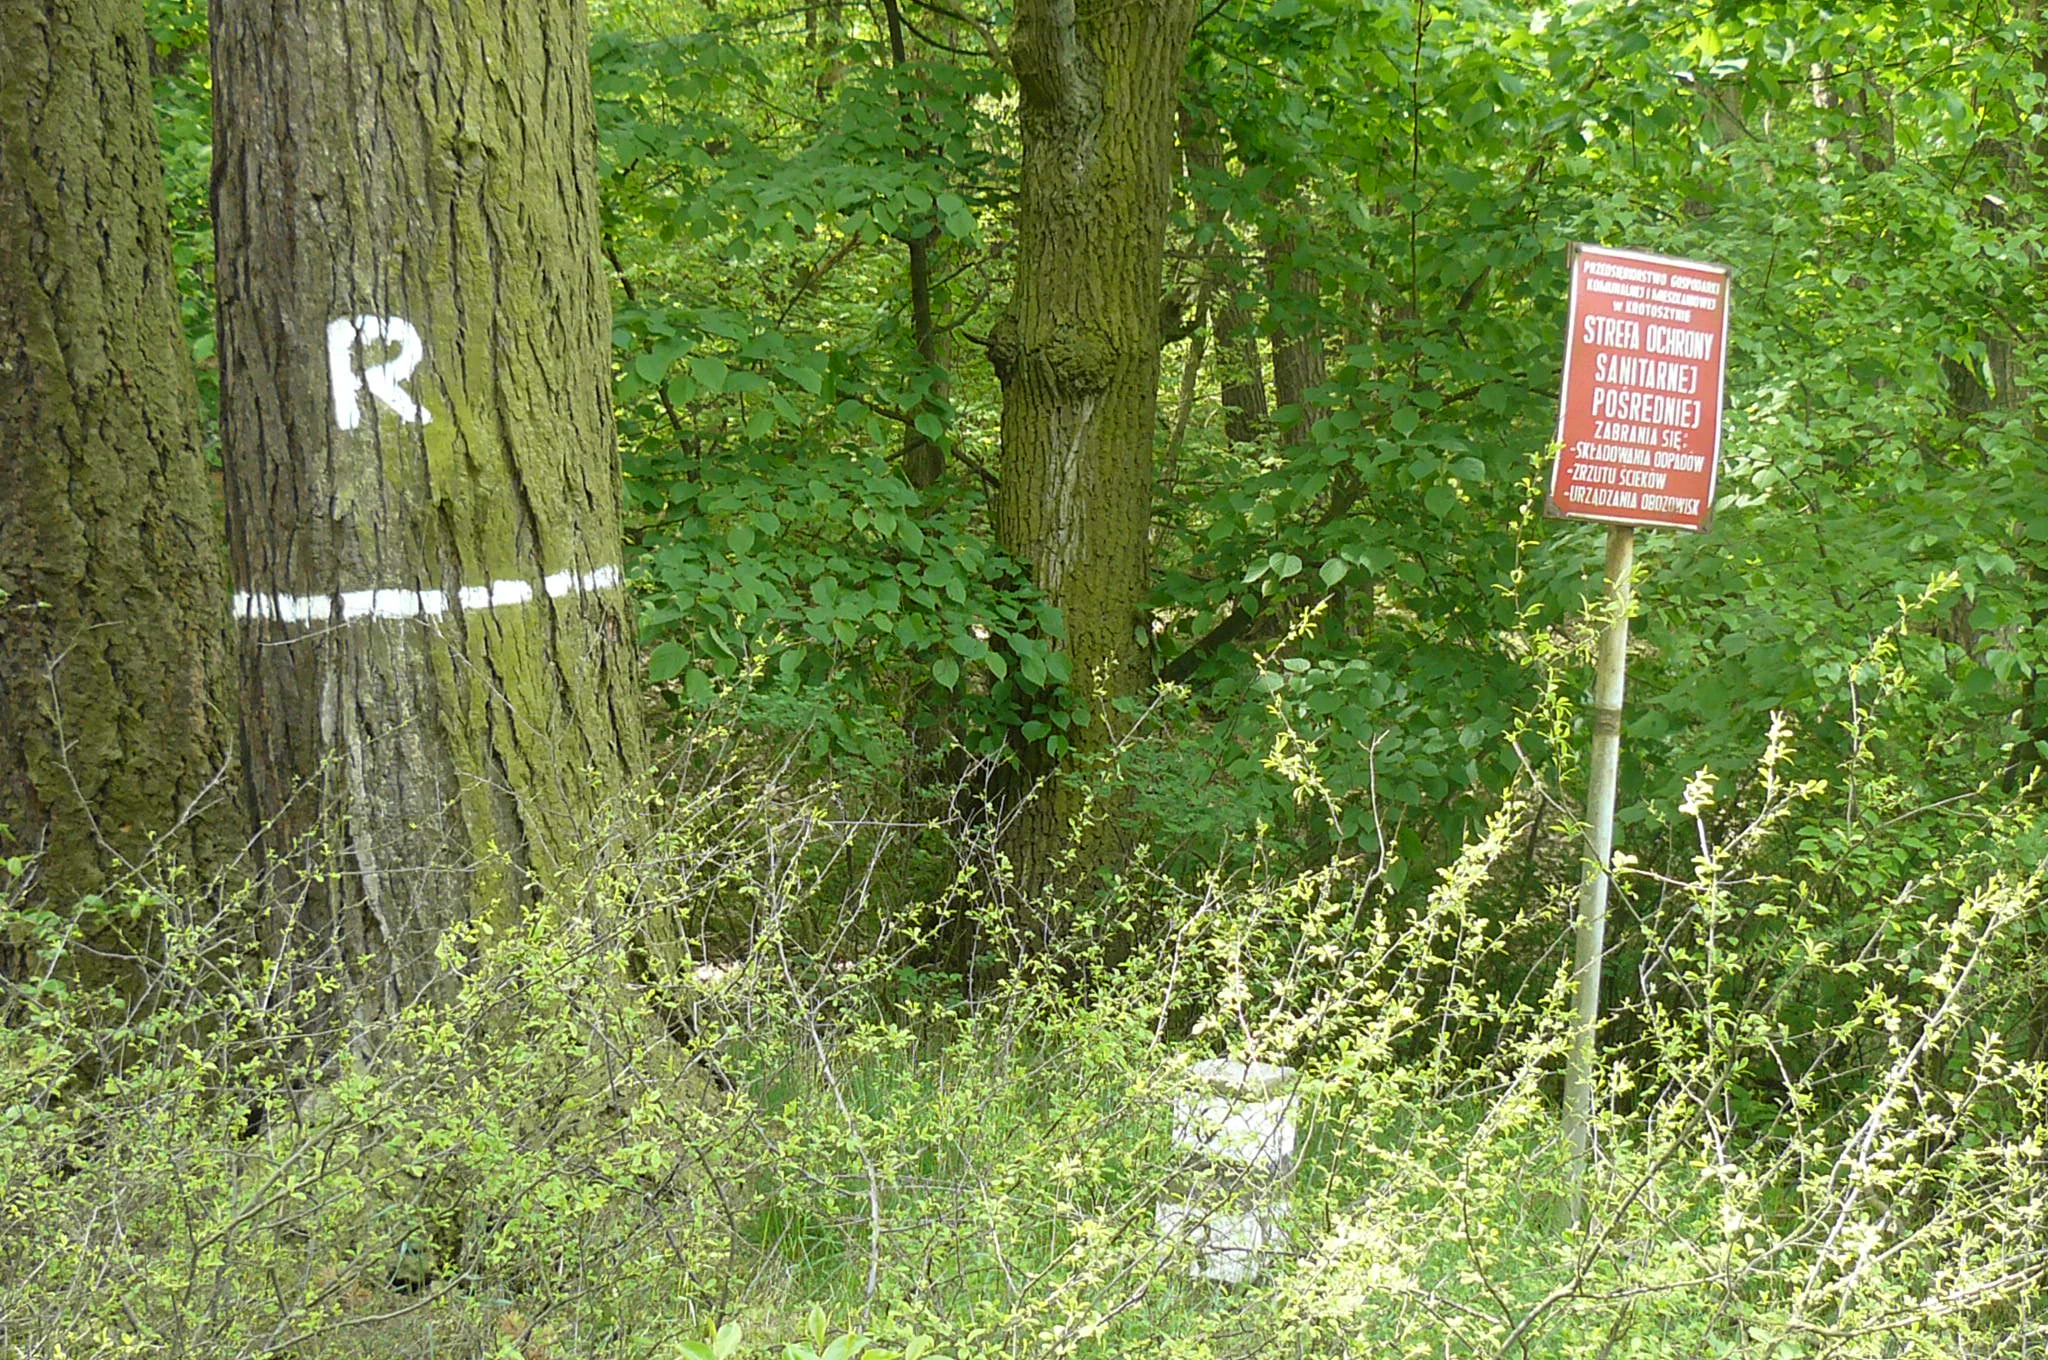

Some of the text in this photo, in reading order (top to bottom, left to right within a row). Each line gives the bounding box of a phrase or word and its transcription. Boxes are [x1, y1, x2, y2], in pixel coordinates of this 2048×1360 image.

[1583, 314, 1714, 361] STREFA OCHRONY
[327, 314, 433, 430] R
[1594, 353, 1698, 394] SANITARNEJ
[1592, 386, 1701, 429] POŚREDNIEJ
[1594, 421, 1658, 446] ZABRANIA
[1618, 465, 1667, 490] ŚCIEKÓW
[1654, 450, 1705, 473] ODPADÓW
[1641, 493, 1701, 516] OBOZOWISK
